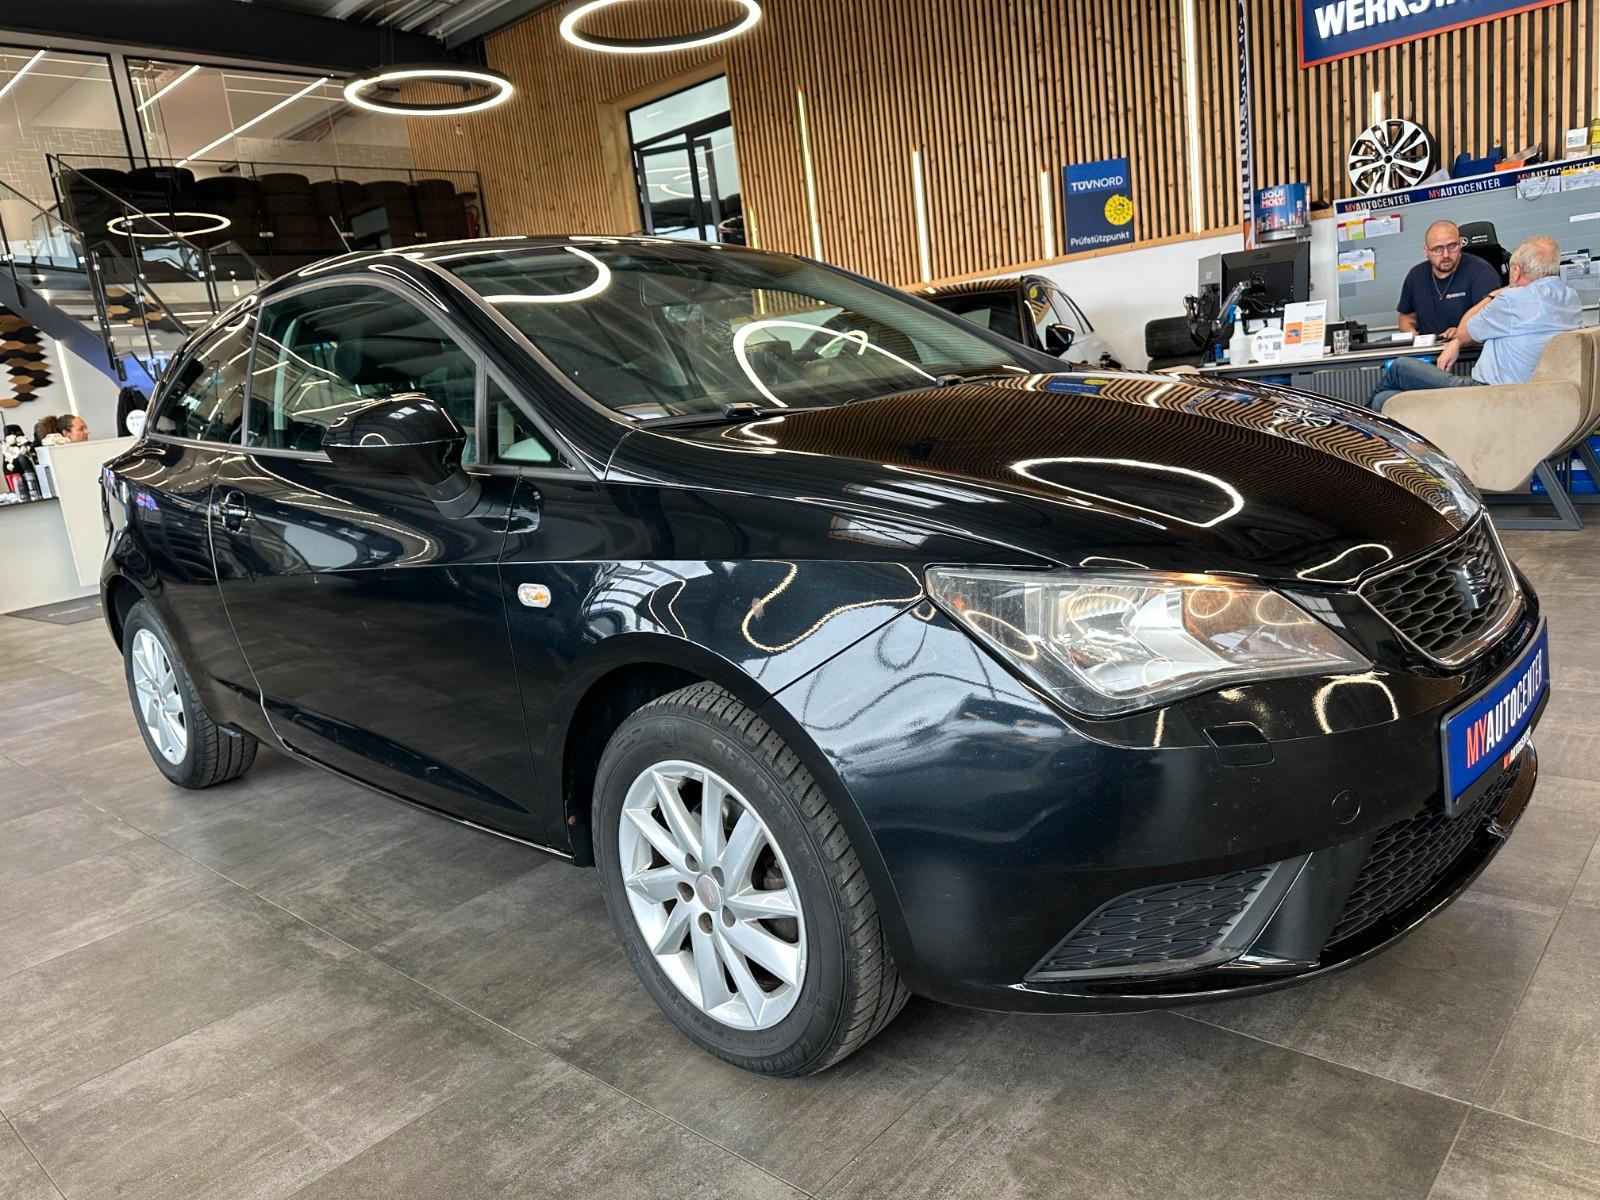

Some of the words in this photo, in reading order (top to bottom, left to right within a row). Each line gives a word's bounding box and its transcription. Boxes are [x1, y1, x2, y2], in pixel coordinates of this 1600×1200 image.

[1314, 0, 1457, 39] WERK
[1428, 178, 1501, 199] MYAUTOCENTER
[1070, 231, 1130, 246] Prüfstützpunkt
[1466, 648, 1542, 768] MYAUTOCENTER
